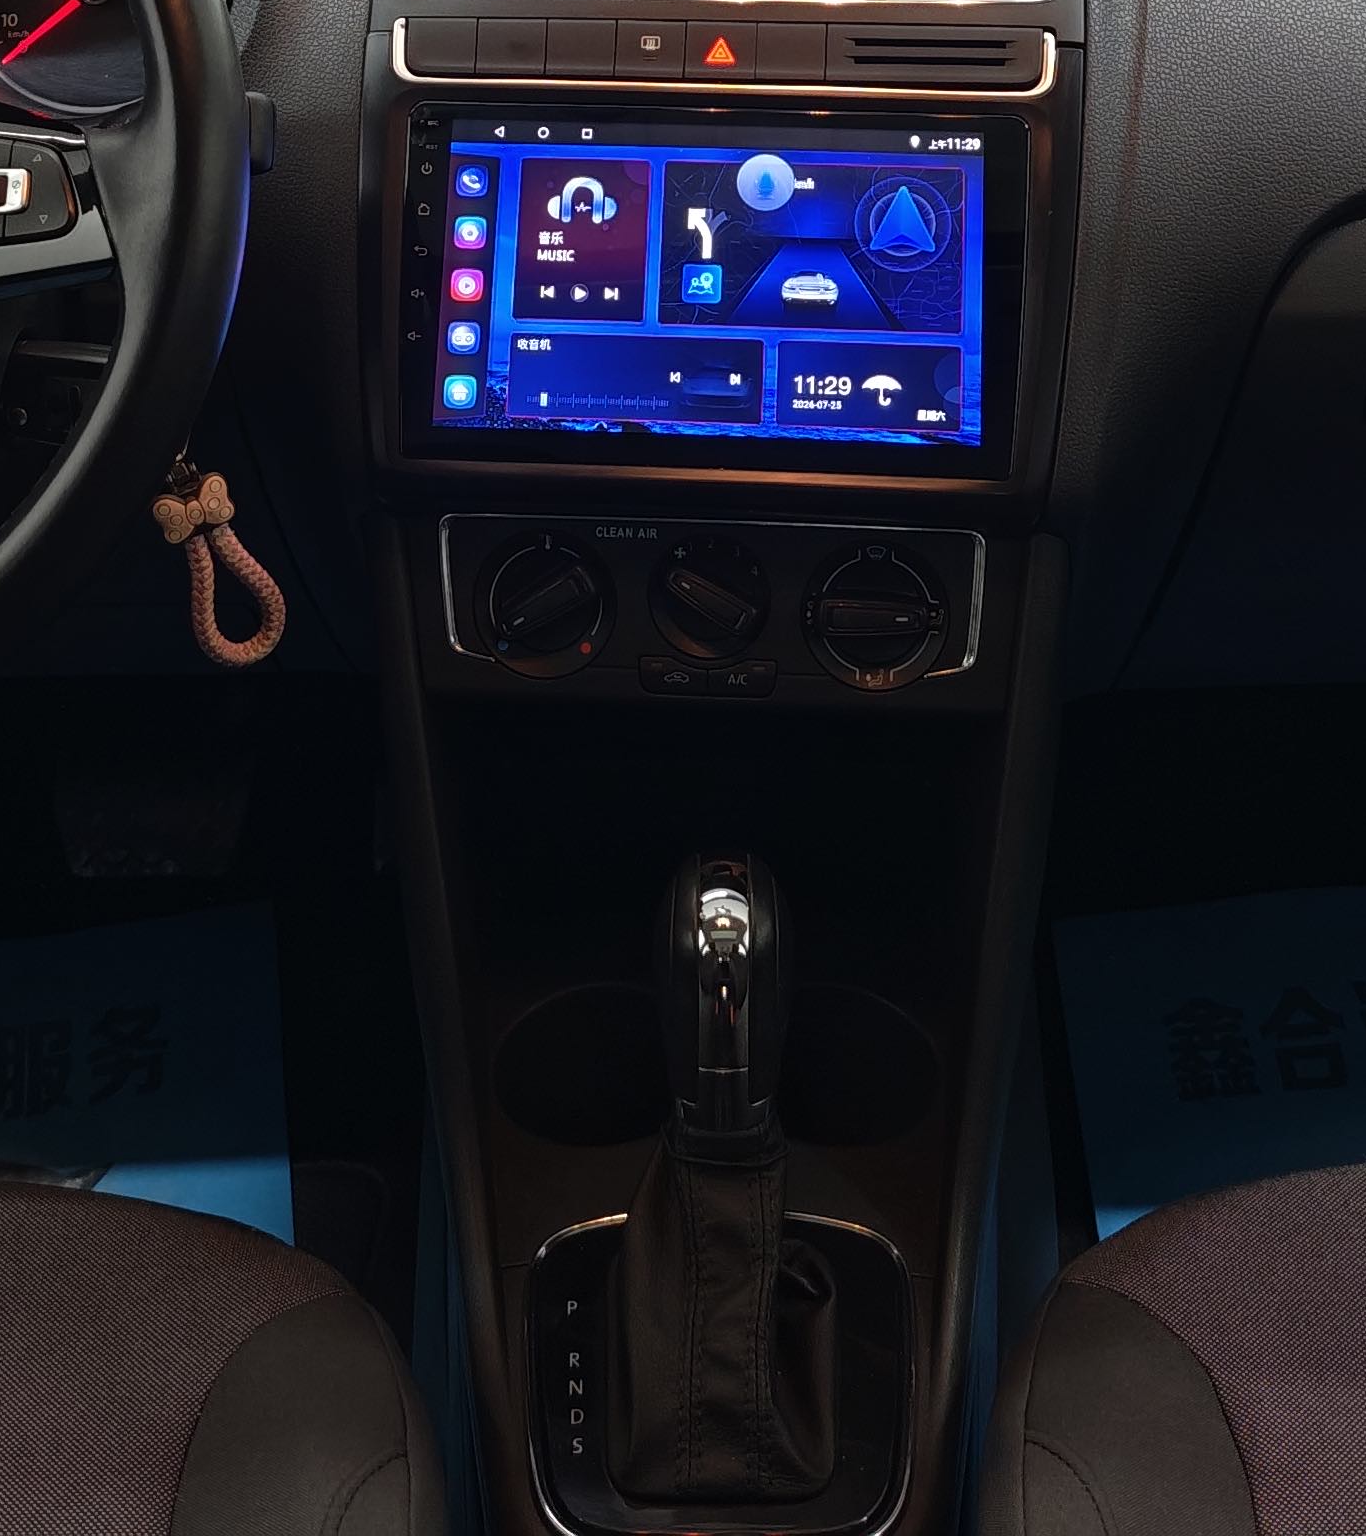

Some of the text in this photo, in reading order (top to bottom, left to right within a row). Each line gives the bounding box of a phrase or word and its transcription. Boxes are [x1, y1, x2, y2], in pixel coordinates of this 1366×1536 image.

[0, 13, 18, 27] 10
[538, 230, 564, 245] 音乐
[536, 248, 576, 262] MUSIC
[517, 338, 552, 351] 收音机
[793, 375, 852, 396] 11:29
[595, 525, 658, 540] CLEAN AIR
[727, 671, 749, 687] A/C
[567, 1301, 584, 1454] P R N D S
